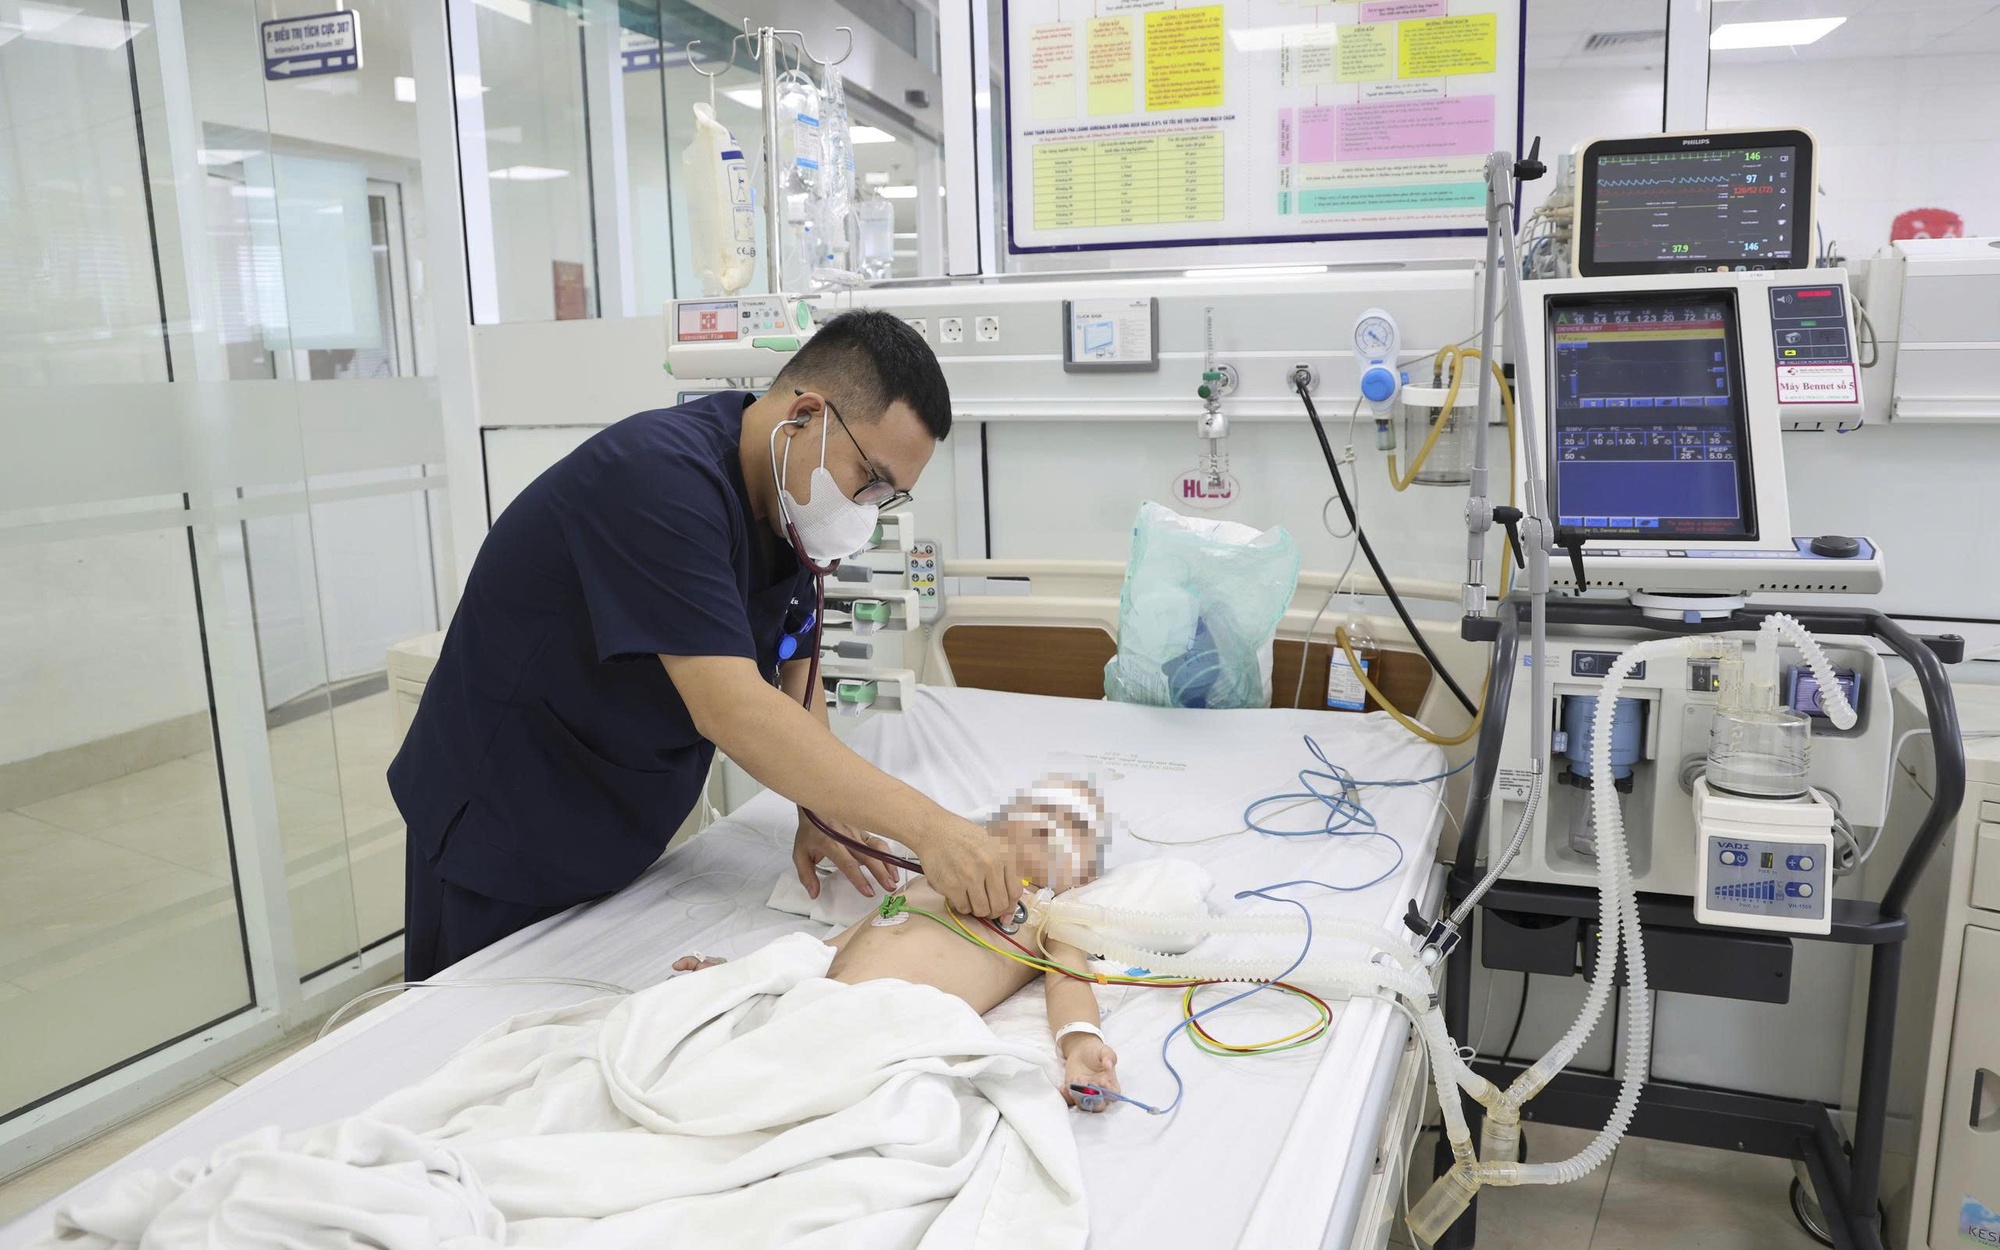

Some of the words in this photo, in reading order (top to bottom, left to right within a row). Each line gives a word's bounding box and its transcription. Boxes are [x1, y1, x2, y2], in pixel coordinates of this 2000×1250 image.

[1682, 138, 1710, 146] PHILIPS
[1744, 152, 1761, 161] 146
[1746, 174, 1758, 184] 97
[1672, 244, 1689, 253] 37.9
[1744, 242, 1759, 251] 146
[1780, 382, 1799, 392] Máy
[1803, 382, 1834, 390] Bennet
[1849, 382, 1855, 390] 5
[1718, 842, 1750, 850] VADI
[1968, 1225, 2000, 1244] KES
